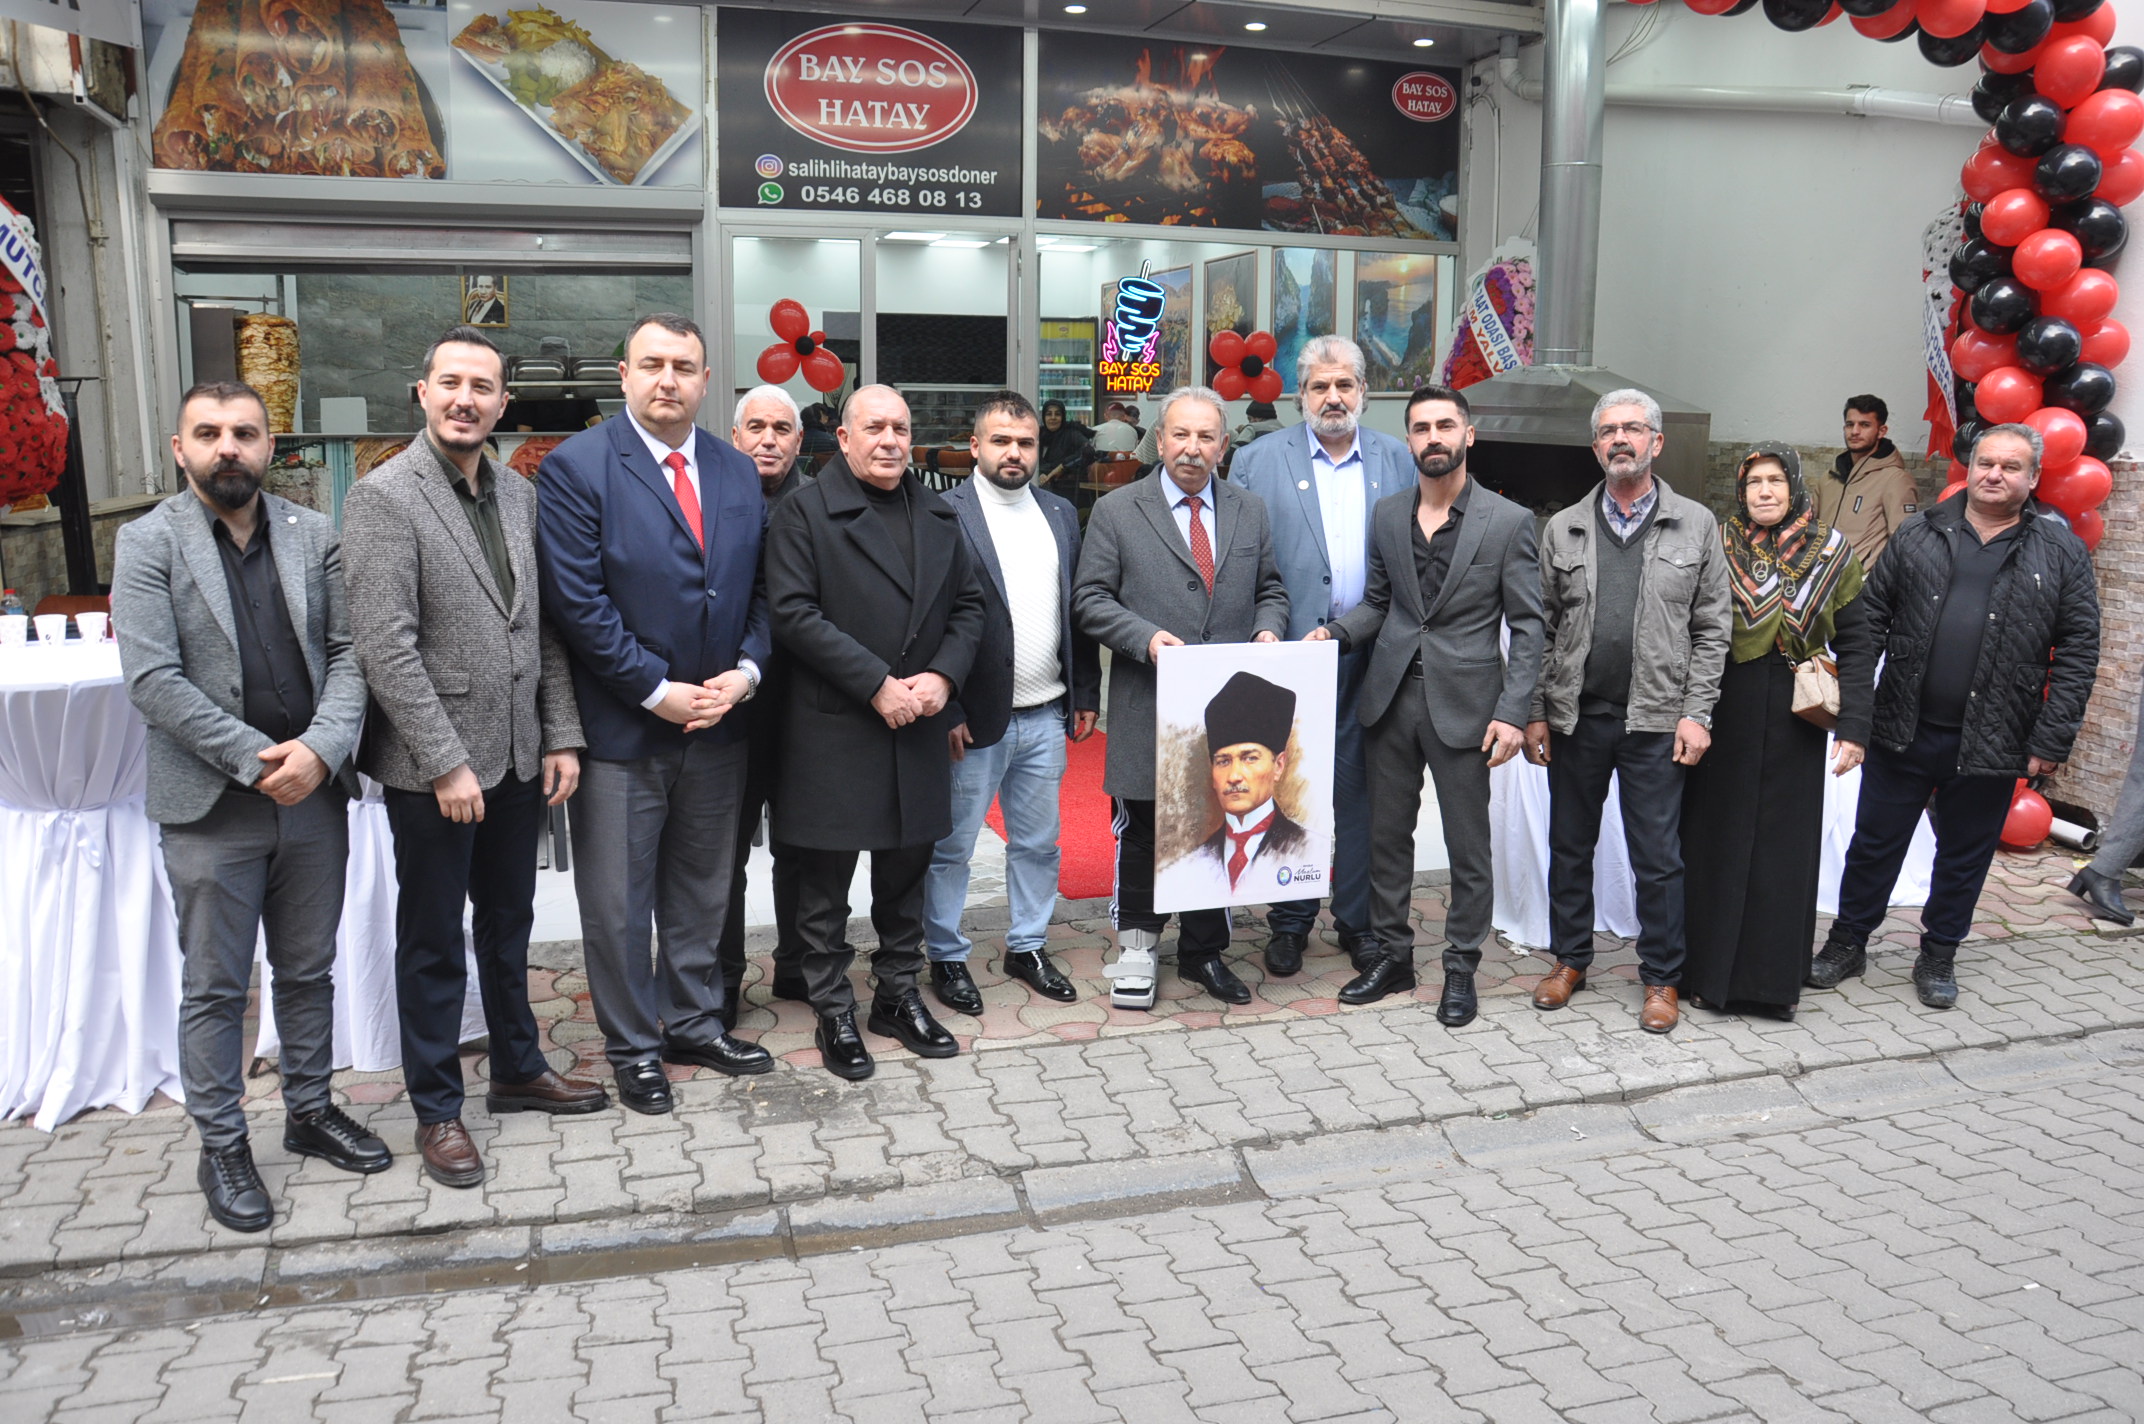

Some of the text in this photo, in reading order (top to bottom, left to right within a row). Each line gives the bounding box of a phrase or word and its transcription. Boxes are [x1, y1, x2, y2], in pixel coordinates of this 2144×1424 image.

[799, 53, 948, 89] BAY SOS
[1402, 82, 1448, 98] BAY SOS
[818, 98, 930, 130] HATAY
[1408, 99, 1442, 113] HATAY
[788, 159, 998, 185] salihlihataybaysosdoner
[801, 185, 982, 209] 0546 468 08 13
[1481, 314, 1506, 347] ODASI
[1099, 361, 1160, 377] BAY SOS
[1106, 375, 1153, 392] HATAY
[1294, 873, 1321, 882] NURLU
